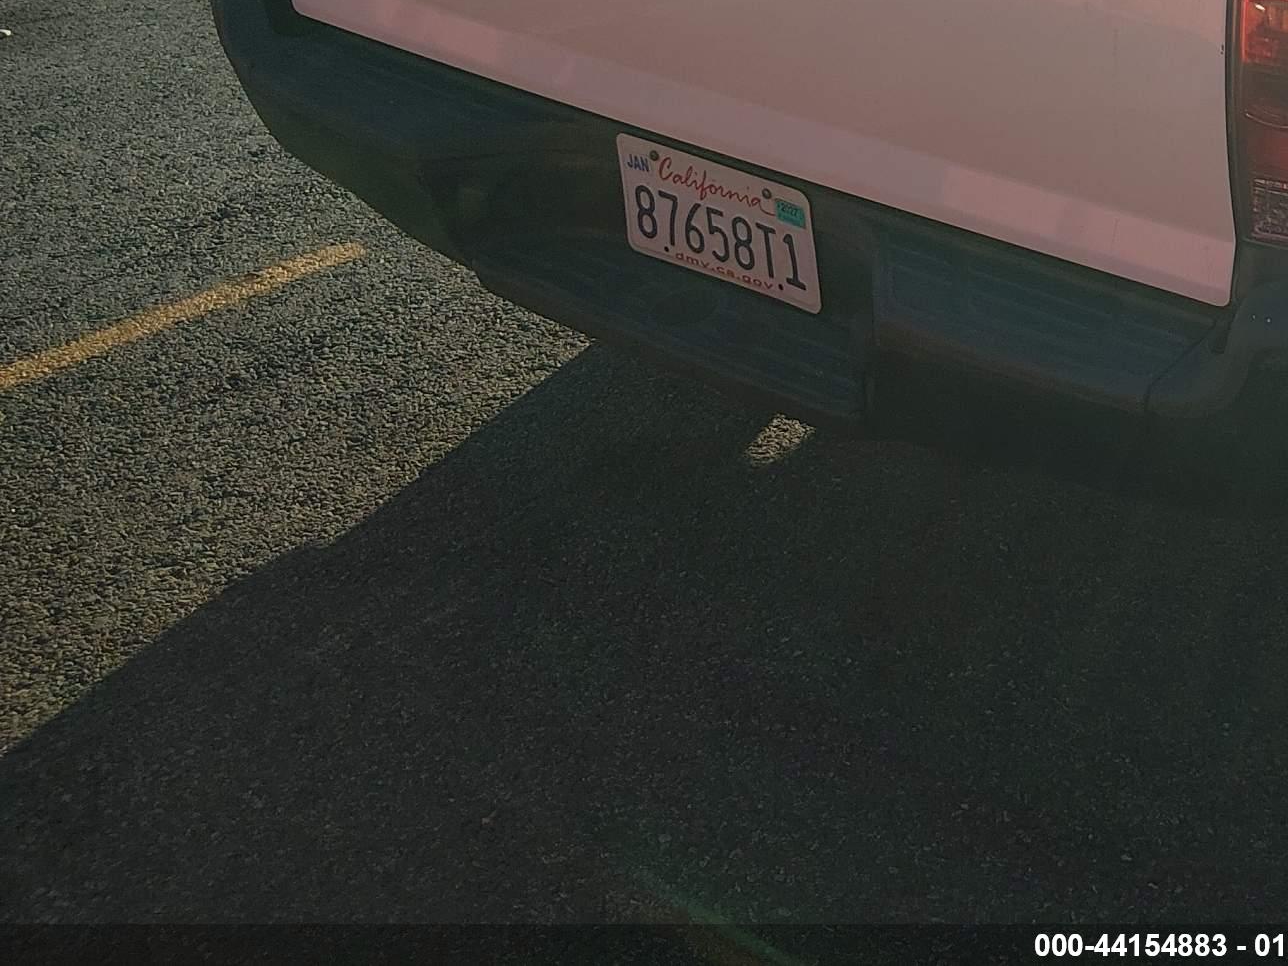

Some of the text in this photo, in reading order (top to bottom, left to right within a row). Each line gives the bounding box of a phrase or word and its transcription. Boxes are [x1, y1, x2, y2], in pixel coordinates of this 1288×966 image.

[627, 153, 650, 173] JAN
[659, 157, 776, 216] California
[635, 185, 807, 291] 87658T1
[675, 253, 774, 290] dmv.ca.gov
